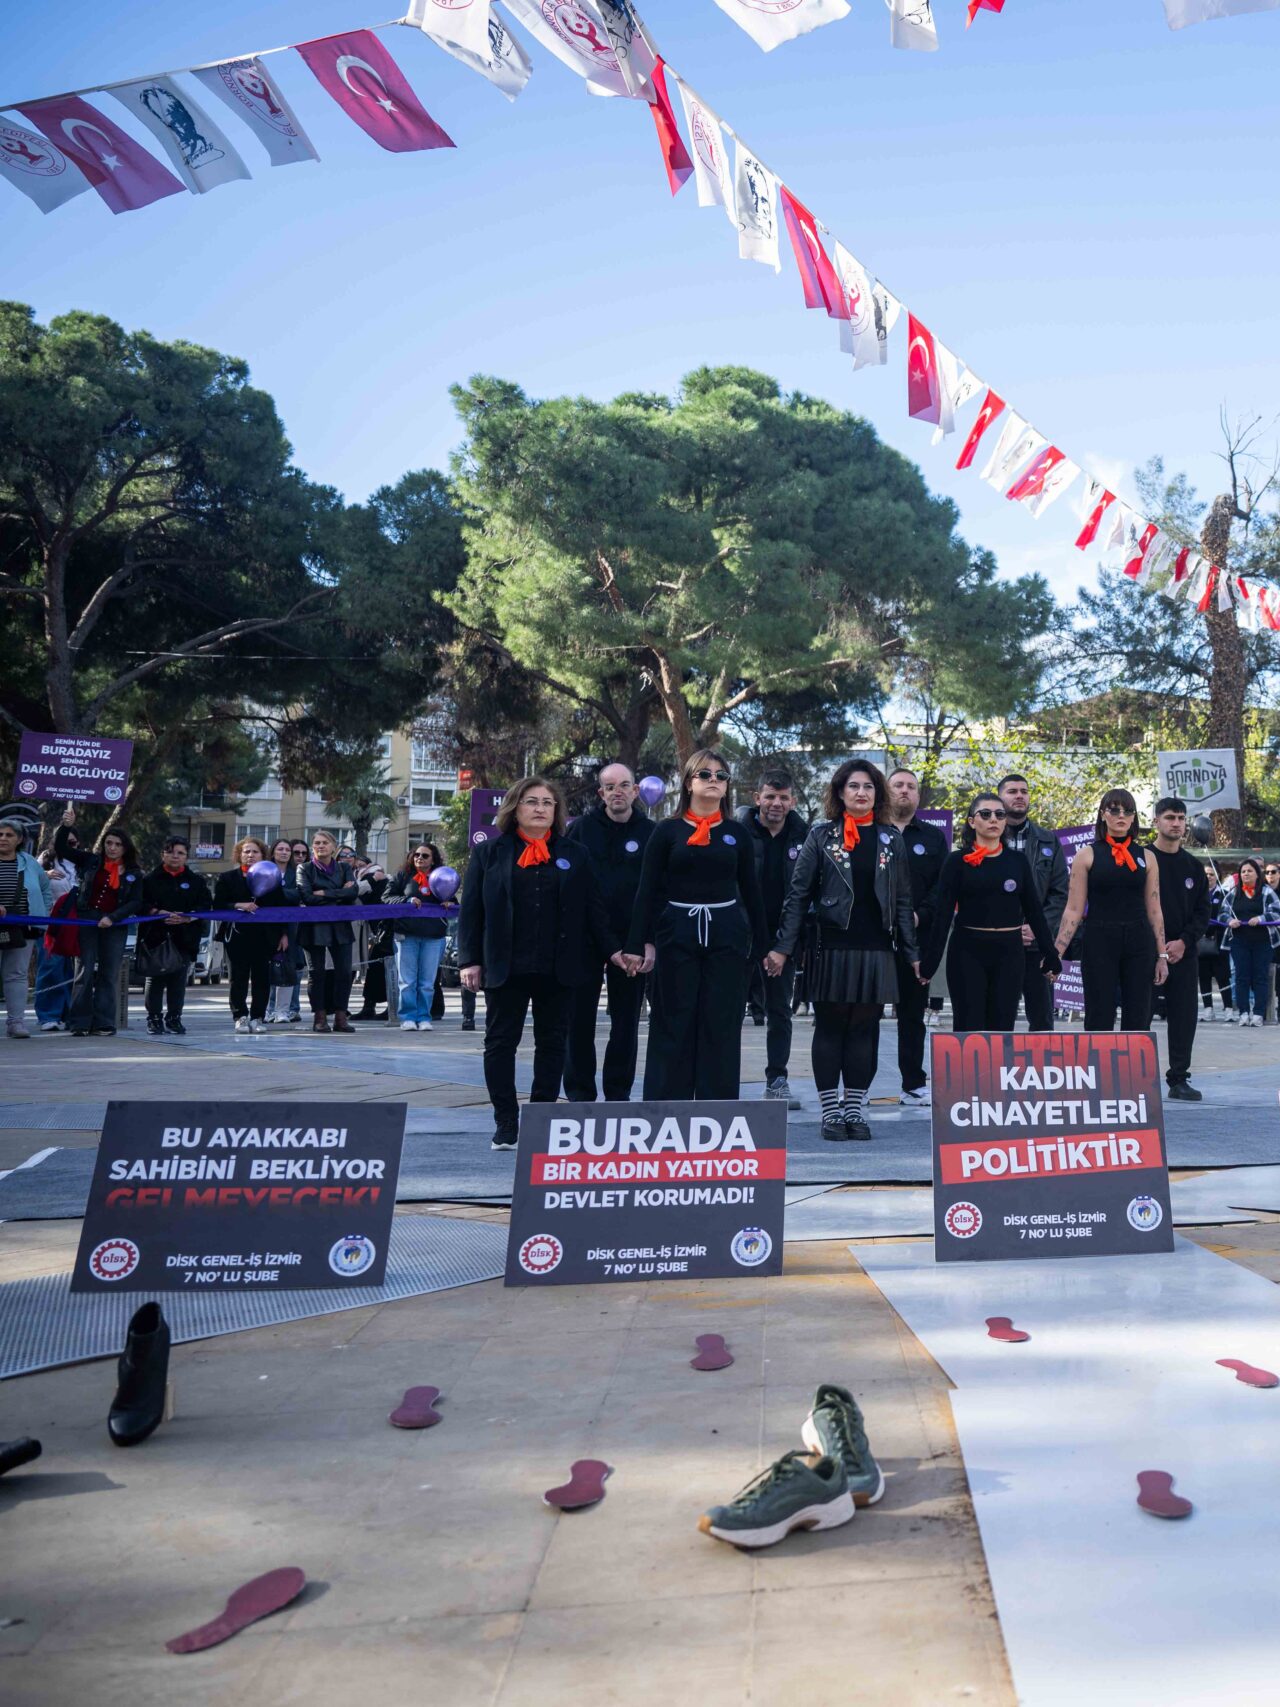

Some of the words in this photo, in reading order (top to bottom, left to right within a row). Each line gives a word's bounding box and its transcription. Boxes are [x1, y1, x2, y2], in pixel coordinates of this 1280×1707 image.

[41, 744, 112, 760] BURADAYIZ
[21, 763, 57, 775] DAHA
[59, 765, 125, 781] GÜÇLÜYÜZ
[1166, 768, 1227, 790] BORNOVA
[1000, 1066, 1096, 1091] KADIN
[950, 1094, 1148, 1127] CİNAYETLERİ
[162, 1127, 202, 1148] BU
[207, 1127, 347, 1148] AYAKKABI
[548, 1116, 757, 1155] BURADA
[961, 1133, 1142, 1178] POLİTİKTİR
[108, 1155, 237, 1180] SAHİBİNİ
[250, 1155, 385, 1179] BEKLİYOR
[543, 1159, 581, 1181] BİR
[587, 1160, 659, 1180] KADIN
[665, 1159, 759, 1177] YATIYOR
[544, 1190, 629, 1209] DEVLET
[634, 1187, 755, 1207] KORUMADI!
[954, 1214, 973, 1223] DİSK
[1003, 1213, 1028, 1226] DİSK
[1030, 1212, 1077, 1225] GENEL-İŞ
[1078, 1211, 1107, 1223] İZMİR
[1019, 1229, 1027, 1240] 7
[1050, 1228, 1063, 1238] LU
[1065, 1227, 1092, 1240] ŞUBE
[102, 1253, 127, 1264] DİSK
[166, 1253, 199, 1267] DİSK
[201, 1252, 262, 1267] GENEL-İŞ
[265, 1252, 302, 1265] İZMİR
[530, 1248, 551, 1258] DİSK
[587, 1247, 615, 1260] DİSK
[618, 1245, 671, 1260] GENEL-İŞ
[674, 1244, 707, 1257] İZMİR
[603, 1264, 611, 1275] 7
[639, 1262, 654, 1273] LU
[657, 1261, 688, 1275] ŞUBE
[184, 1272, 193, 1283] 7
[223, 1271, 240, 1282] LU
[244, 1270, 279, 1284] ŞUBE
